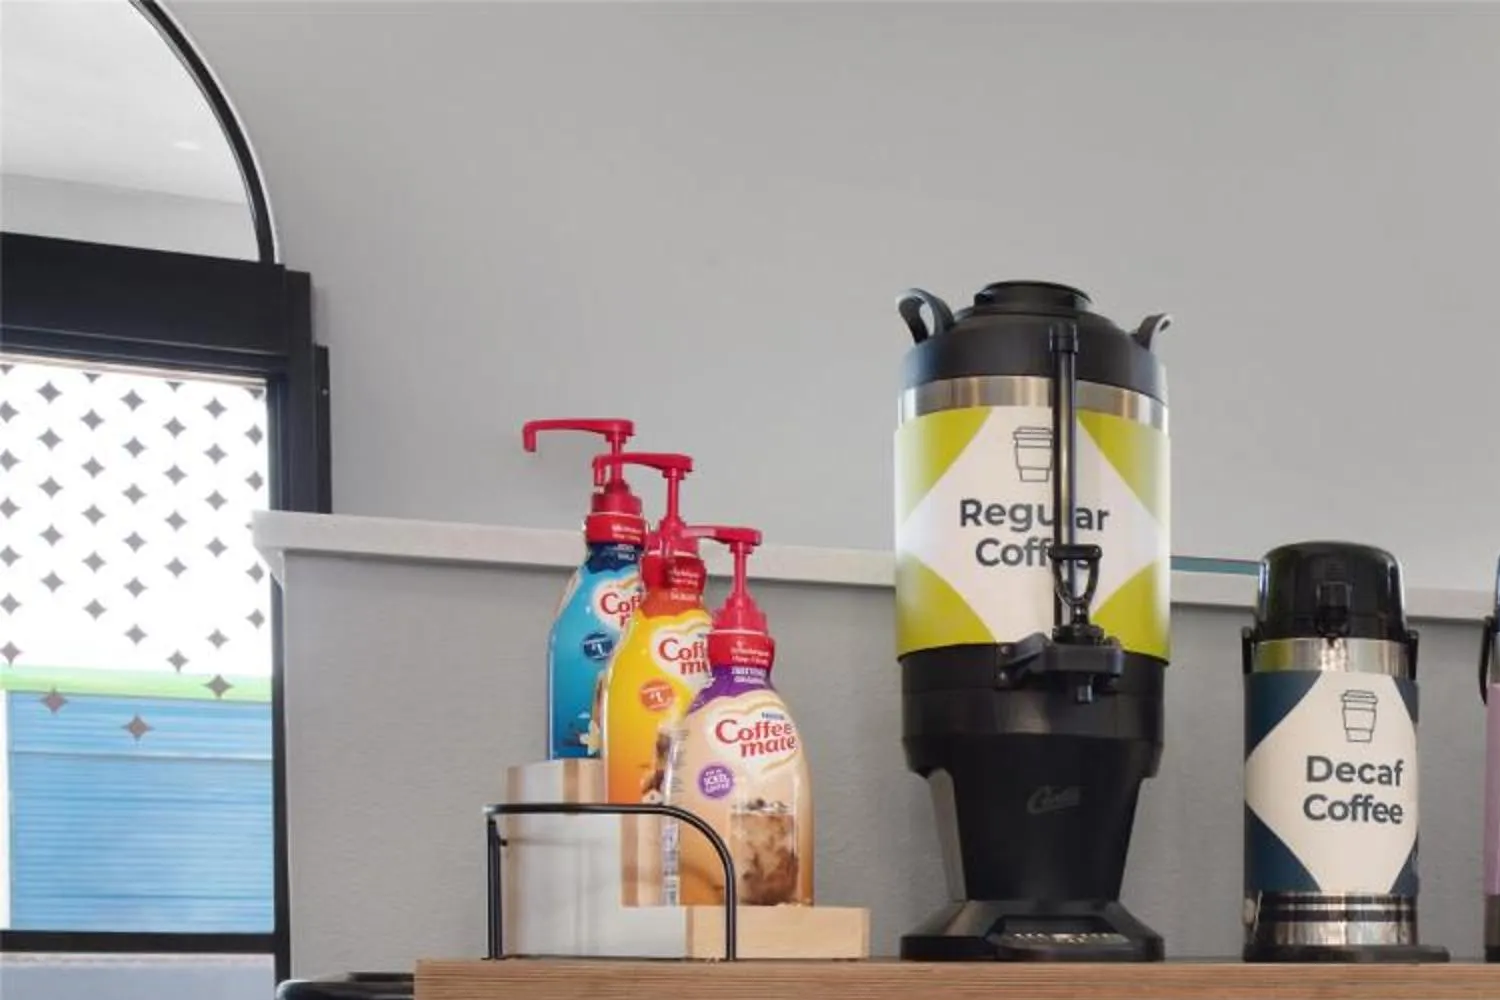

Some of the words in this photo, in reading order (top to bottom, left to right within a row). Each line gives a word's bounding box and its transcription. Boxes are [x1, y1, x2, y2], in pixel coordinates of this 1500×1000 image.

[959, 498, 1111, 533] Reguar
[975, 536, 1091, 569] Coff
[658, 637, 707, 662] Coff
[715, 718, 792, 744] Coffee
[740, 735, 797, 758] mate
[1305, 754, 1405, 787] Decaf
[1302, 792, 1404, 825] Coffee
